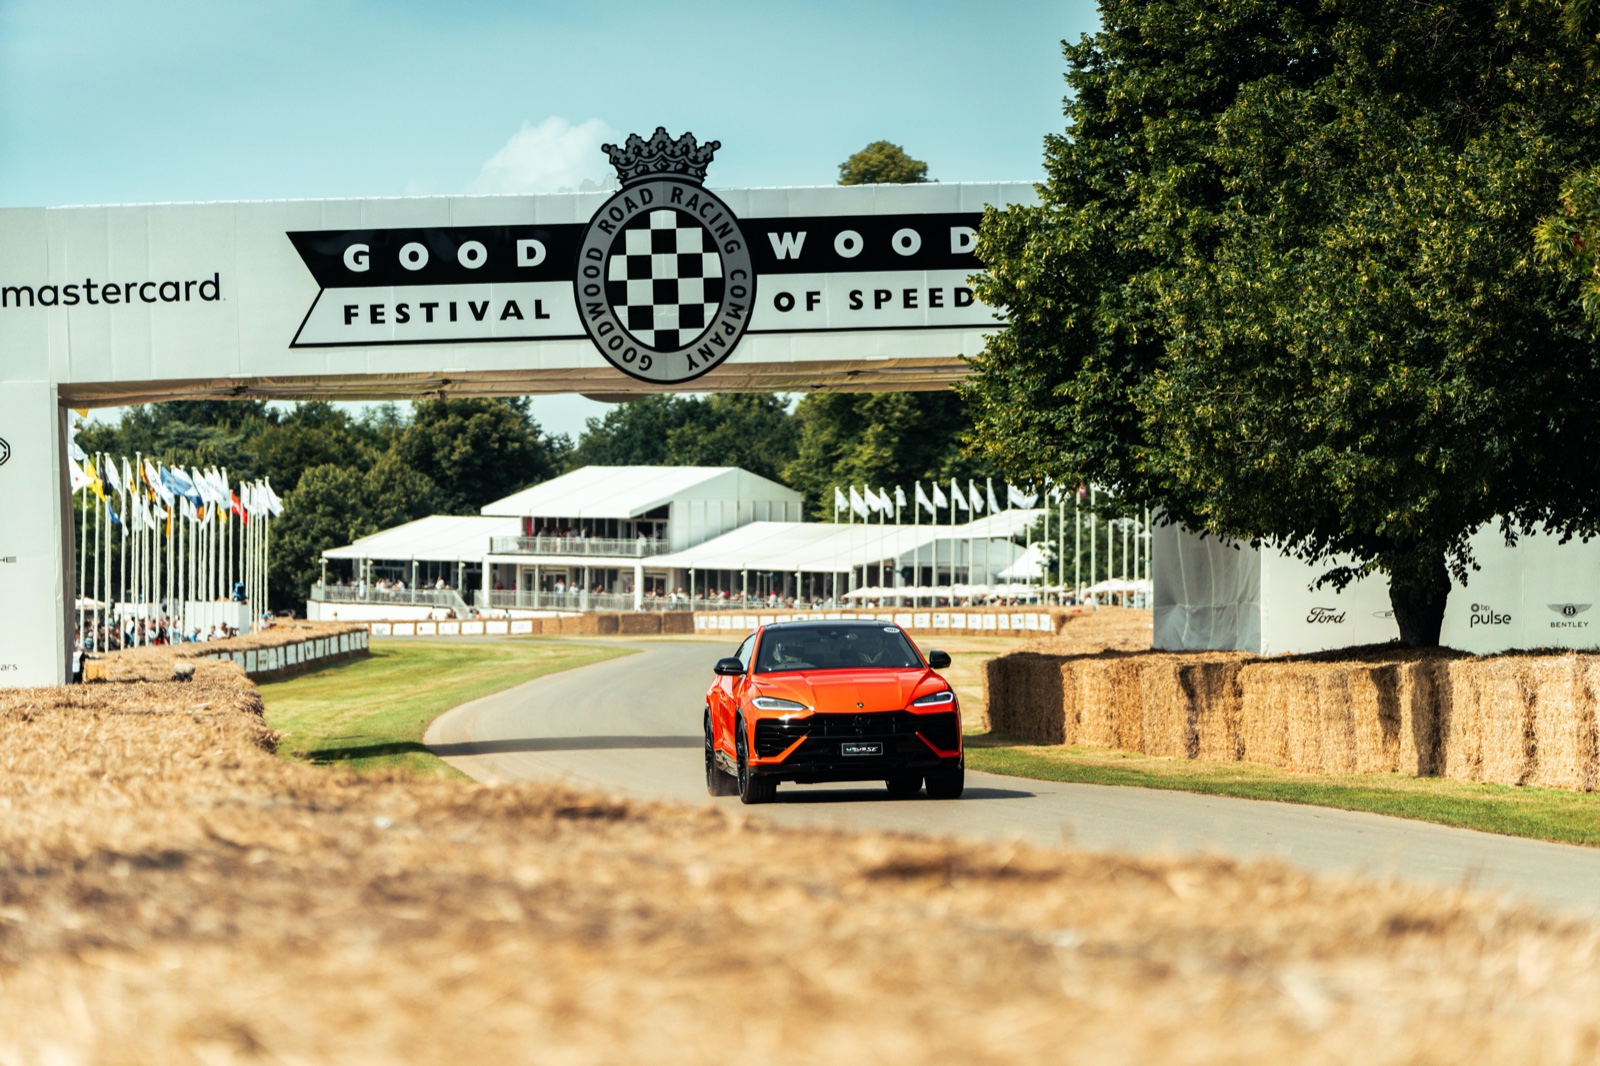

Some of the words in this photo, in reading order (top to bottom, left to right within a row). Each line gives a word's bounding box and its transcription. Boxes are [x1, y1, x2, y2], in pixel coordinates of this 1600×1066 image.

[597, 188, 654, 236] ROAD
[670, 186, 741, 255] RACING
[343, 238, 547, 273] GOOD
[767, 226, 979, 260] WOOD
[1, 272, 220, 308] mastercard
[343, 299, 551, 325] FESTIVAL
[773, 290, 821, 313] OF
[848, 287, 976, 311] SPEED
[582, 247, 653, 372] GOODWOOD
[686, 269, 748, 372] COMPANY
[1306, 607, 1346, 624] Ford
[1470, 610, 1512, 628] pulse
[1480, 604, 1491, 612] bp
